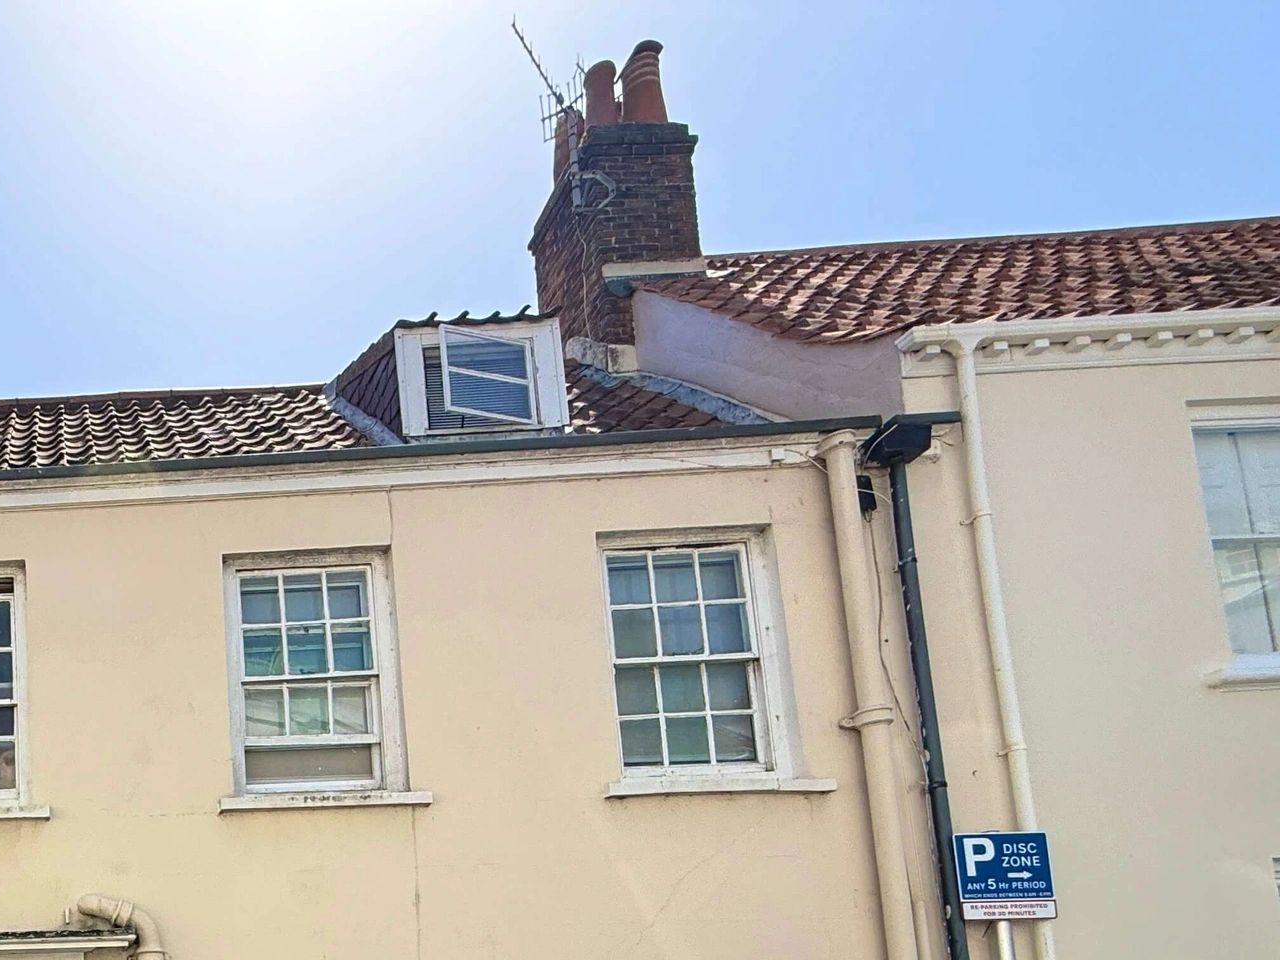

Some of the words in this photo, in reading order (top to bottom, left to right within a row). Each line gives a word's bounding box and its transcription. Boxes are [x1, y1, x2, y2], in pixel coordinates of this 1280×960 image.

[1003, 843, 1038, 854] DISC
[962, 837, 995, 877] P
[1001, 856, 1041, 867] ZONE
[967, 882, 985, 890] ANY
[987, 879, 996, 890] 5
[999, 882, 1009, 890] Hr
[1012, 881, 1046, 889] PERIOD
